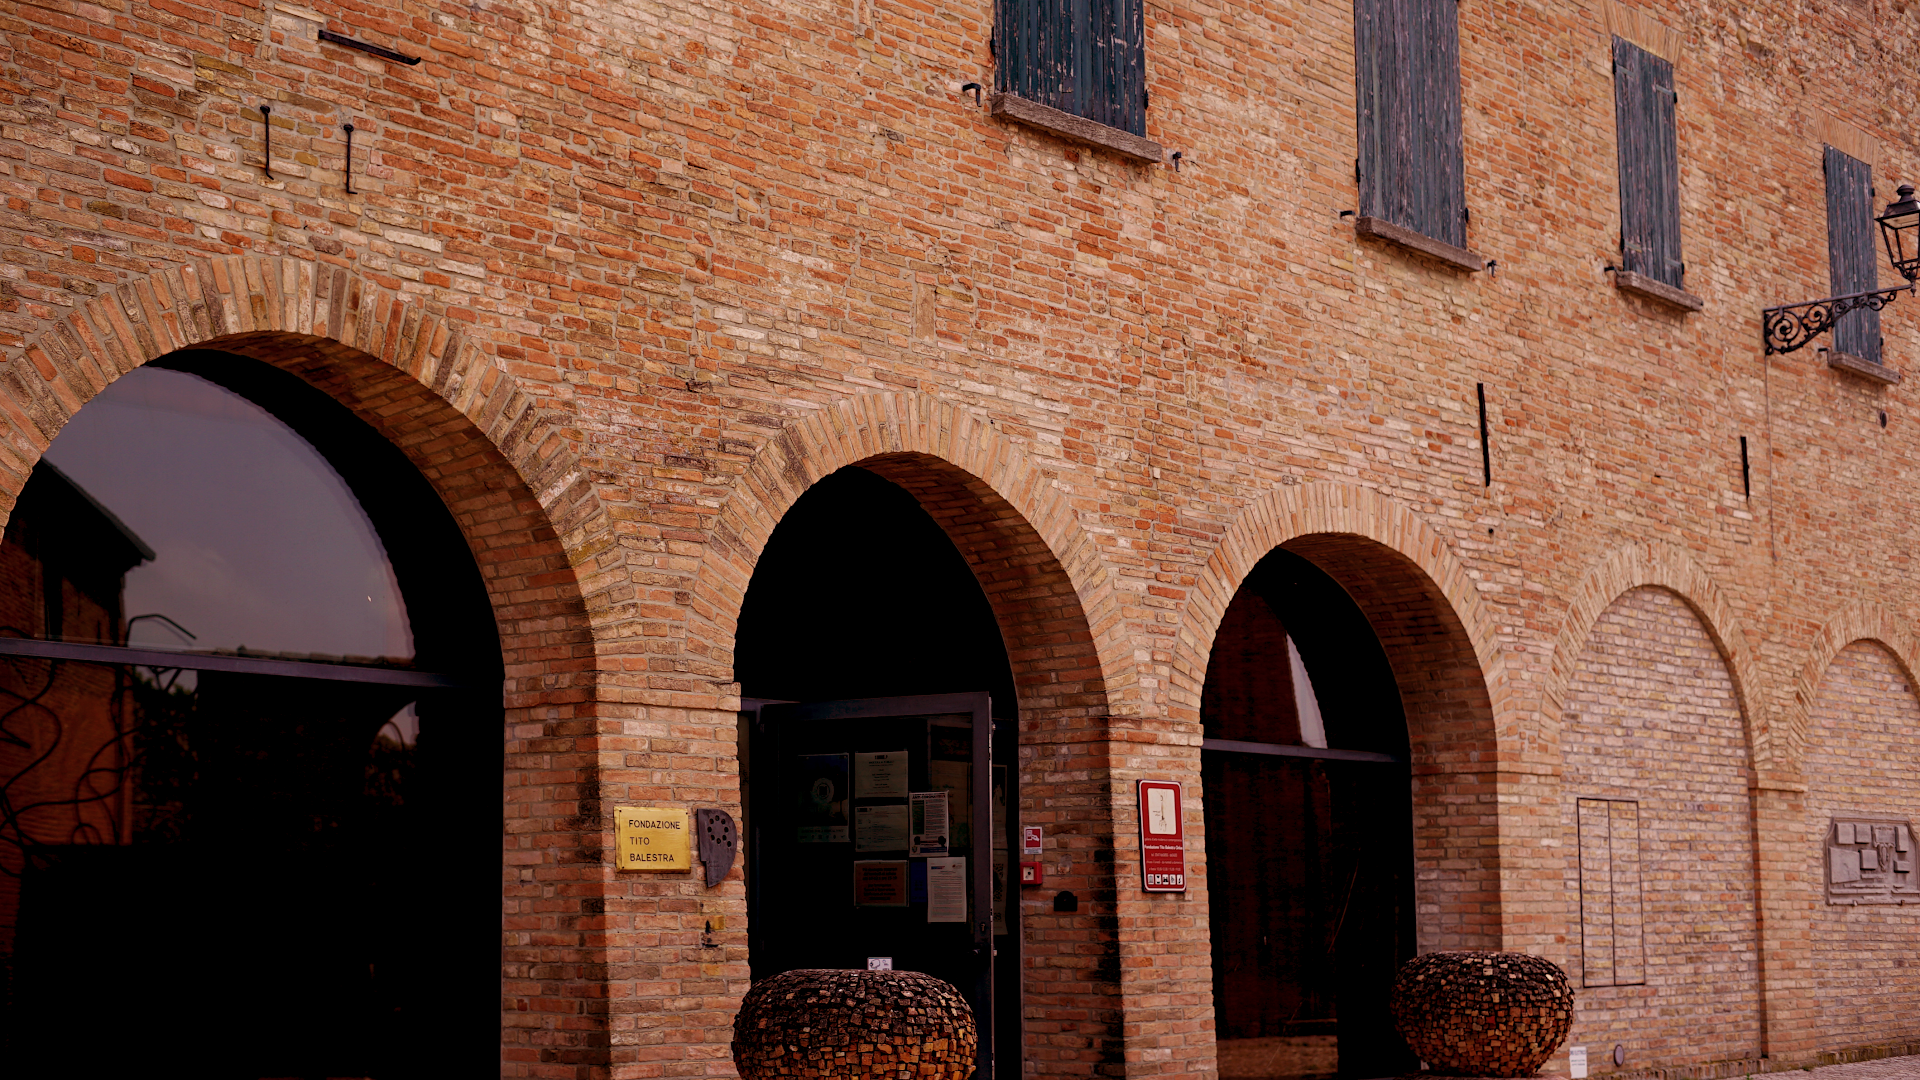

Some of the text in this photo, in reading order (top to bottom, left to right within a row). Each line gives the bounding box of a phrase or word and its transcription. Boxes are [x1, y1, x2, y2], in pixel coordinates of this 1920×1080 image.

[628, 819, 681, 830] FONDAZIONE
[629, 836, 650, 846] TITO
[629, 853, 675, 863] BALESTRA
